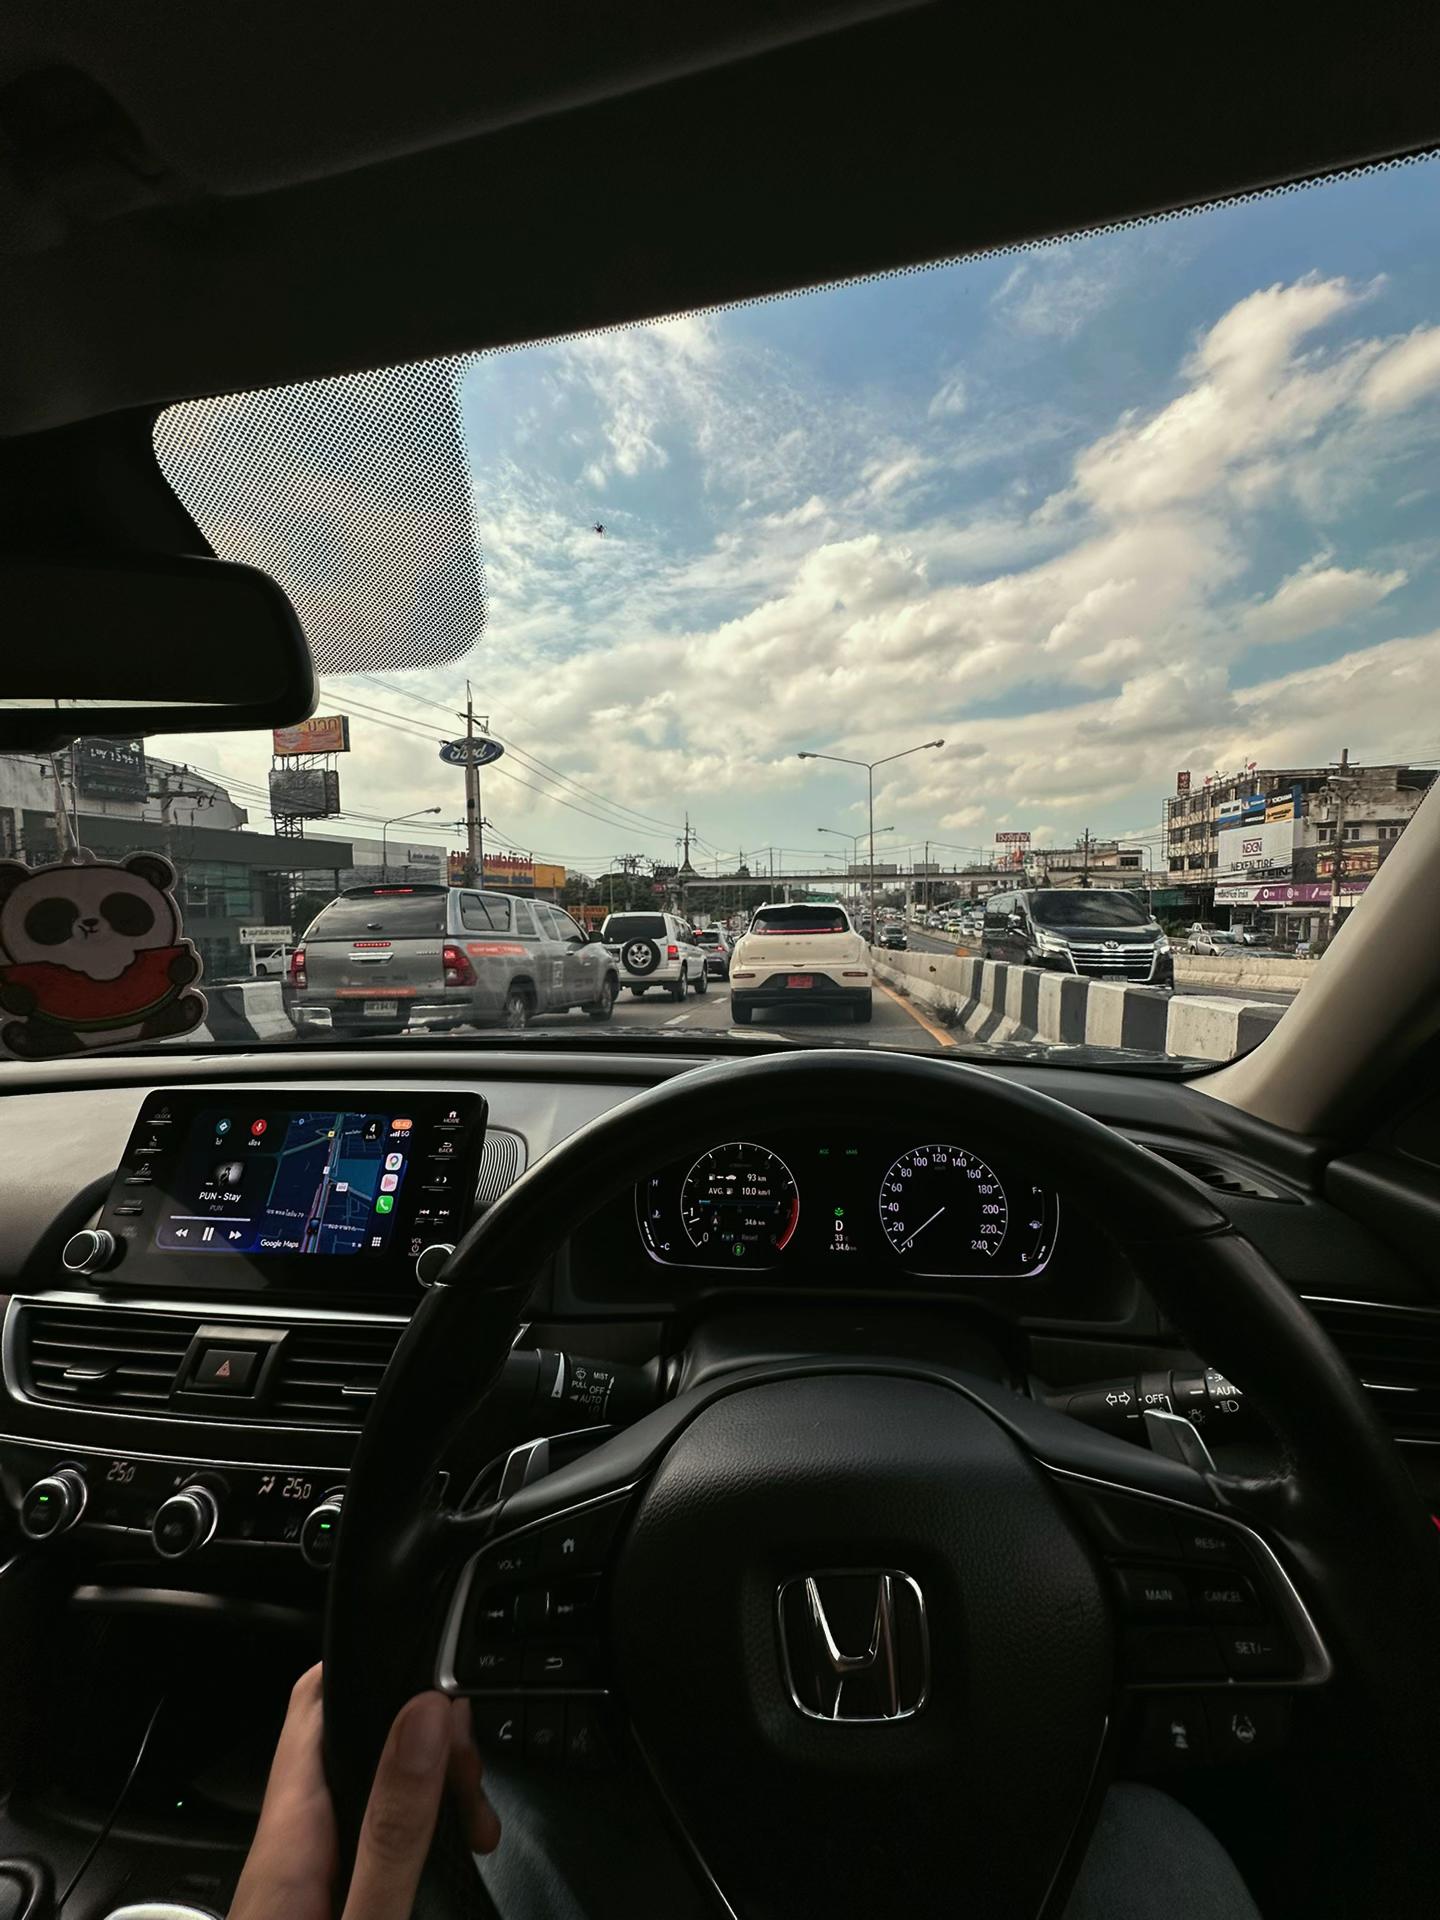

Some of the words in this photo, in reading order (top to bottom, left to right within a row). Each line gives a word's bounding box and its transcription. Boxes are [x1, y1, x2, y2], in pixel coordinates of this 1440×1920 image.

[369, 1123, 377, 1133] 4
[913, 1157, 928, 1168] 100
[932, 1153, 948, 1164] 120
[952, 1157, 967, 1168] 140
[747, 1173, 757, 1182] 93
[900, 1168, 913, 1178] 80
[966, 1169, 982, 1180] 160
[652, 1178, 659, 1188] H
[891, 1182, 903, 1193] 60
[708, 1187, 724, 1195] AVG.
[742, 1187, 757, 1196] 10.0
[977, 1184, 993, 1195] 180
[1031, 1186, 1038, 1195] F
[198, 1191, 218, 1201] PUN
[223, 1192, 243, 1203] Stay
[690, 1207, 694, 1217] 1
[887, 1202, 900, 1213] 40
[982, 1204, 999, 1215] 200
[835, 1219, 844, 1232] D
[892, 1221, 905, 1232] 20
[980, 1224, 997, 1235] 220
[702, 1232, 710, 1243] 0
[834, 1233, 844, 1242] 33
[260, 1238, 282, 1249] Google
[282, 1240, 299, 1249] Maps
[664, 1242, 671, 1251] C
[907, 1239, 914, 1249] 0
[971, 1239, 988, 1251] 240
[1020, 1252, 1027, 1262] E
[593, 1371, 609, 1381] MIST
[571, 1379, 588, 1389] PULL
[589, 1385, 605, 1395] OFF
[1216, 1386, 1242, 1397] AUT
[579, 1394, 603, 1404] AUTO
[1145, 1393, 1164, 1405] OFF
[1144, 1589, 1173, 1601] MAIN
[1203, 1590, 1244, 1603] CANCEL
